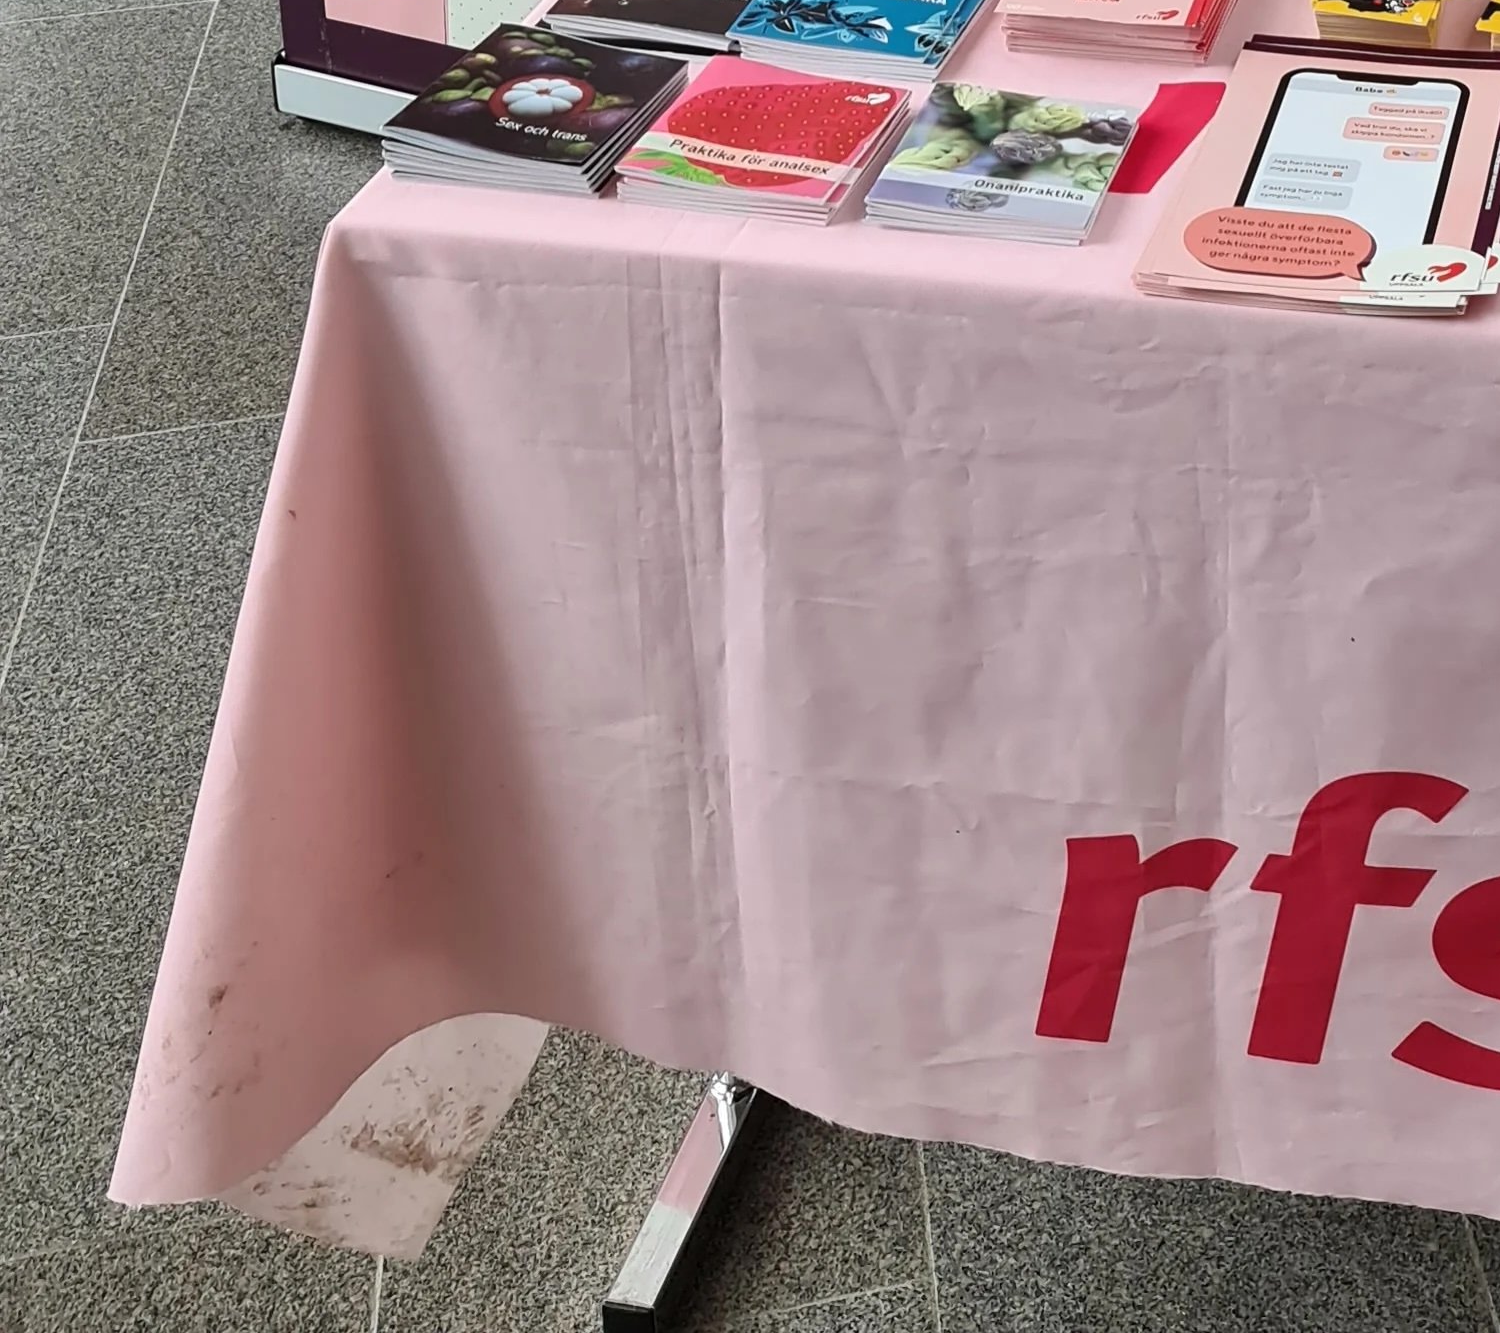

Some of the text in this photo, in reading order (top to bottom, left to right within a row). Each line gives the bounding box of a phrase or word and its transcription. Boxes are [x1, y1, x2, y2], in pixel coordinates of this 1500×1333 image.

[495, 116, 588, 143] Sex och trans
[668, 138, 831, 177] Praktika för analsex
[974, 179, 1084, 201] Onanipraktika
[1218, 215, 1352, 236] Visste du att de flesta
[1217, 227, 1343, 246] sexuellt överförbara
[1201, 237, 1355, 258] infektionerna oftast inte
[1209, 250, 1341, 268] ger några symptom?
[1390, 272, 1435, 283] rfsu
